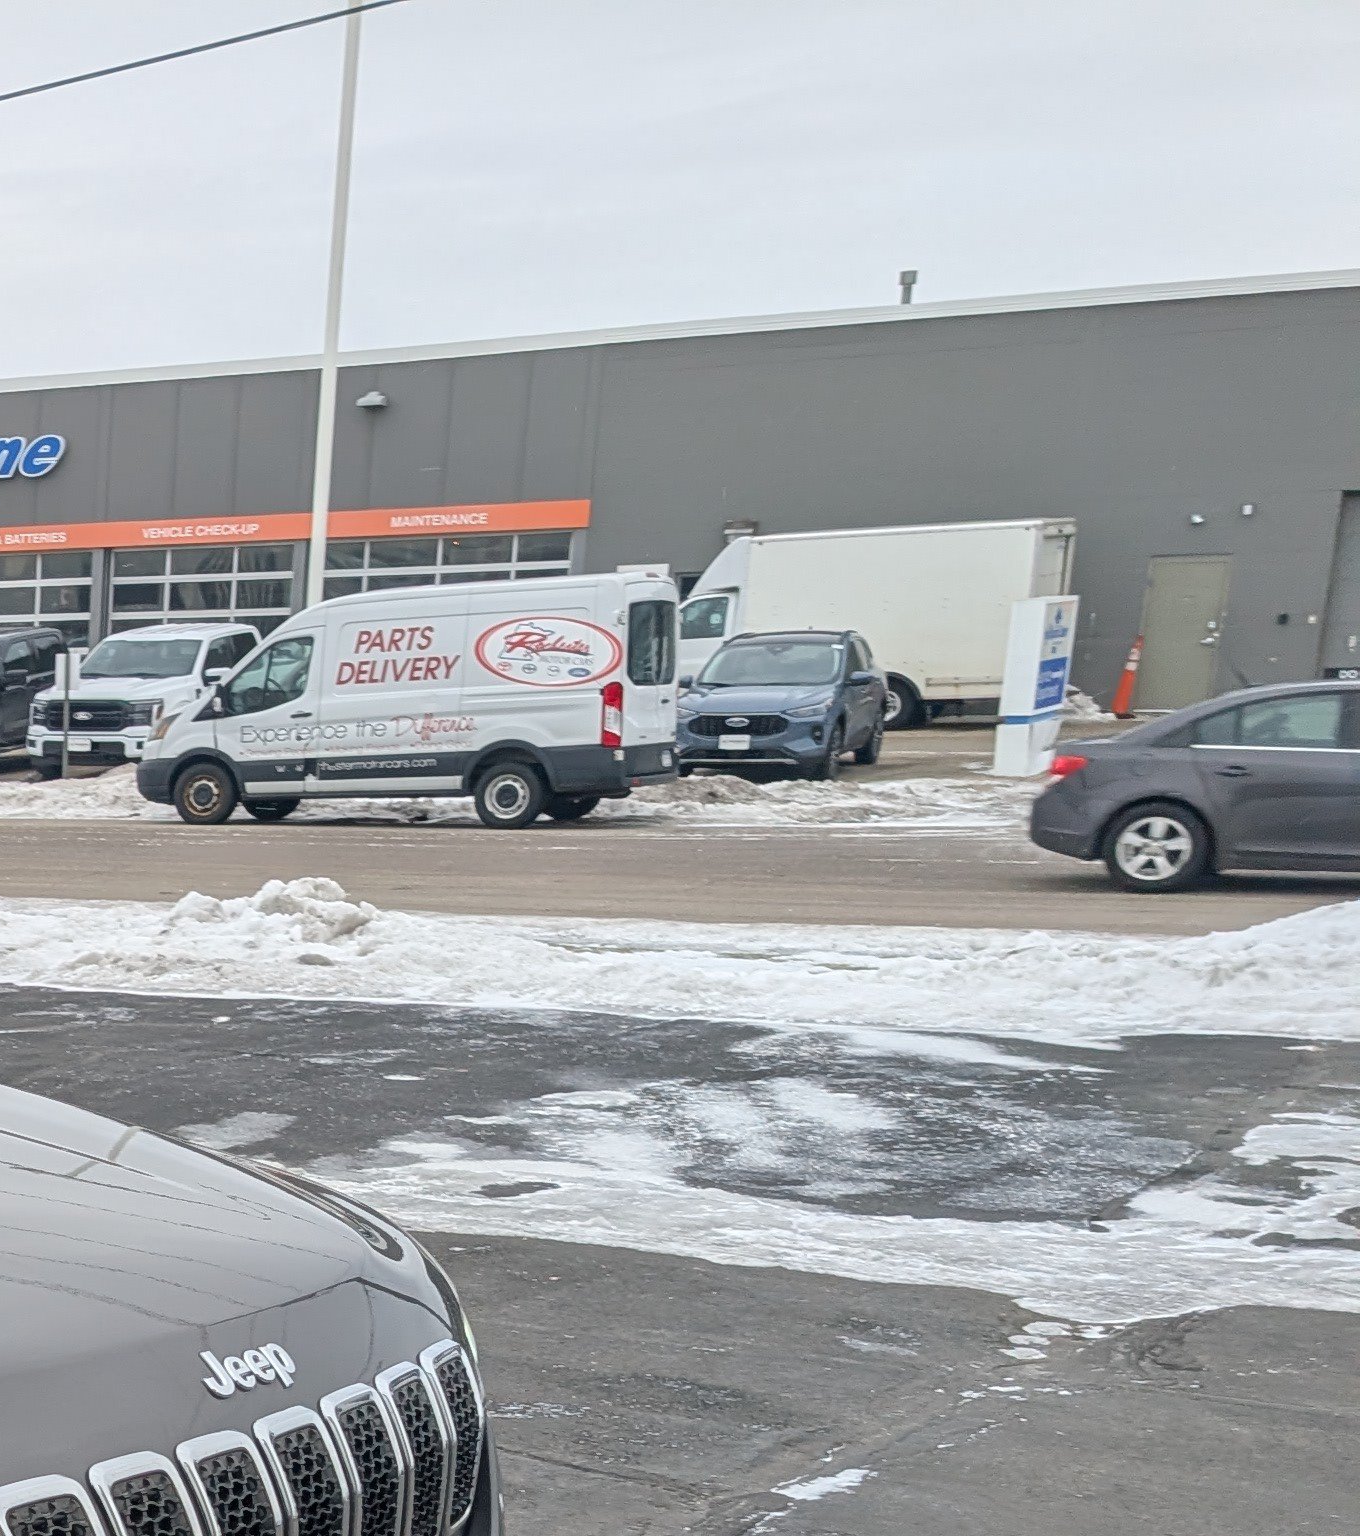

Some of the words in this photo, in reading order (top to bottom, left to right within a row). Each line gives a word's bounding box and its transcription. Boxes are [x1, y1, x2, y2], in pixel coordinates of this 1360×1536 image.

[142, 526, 193, 539] VEHICLE
[196, 523, 260, 537] CHECK-UP
[390, 513, 489, 528] MAINTENANCE
[4, 532, 68, 545] BATTERIES
[354, 626, 435, 654] PARTS
[335, 654, 461, 685] DELIVERY
[239, 724, 348, 746] Experience
[355, 720, 387, 737] the
[198, 1342, 296, 1400] Jeep
